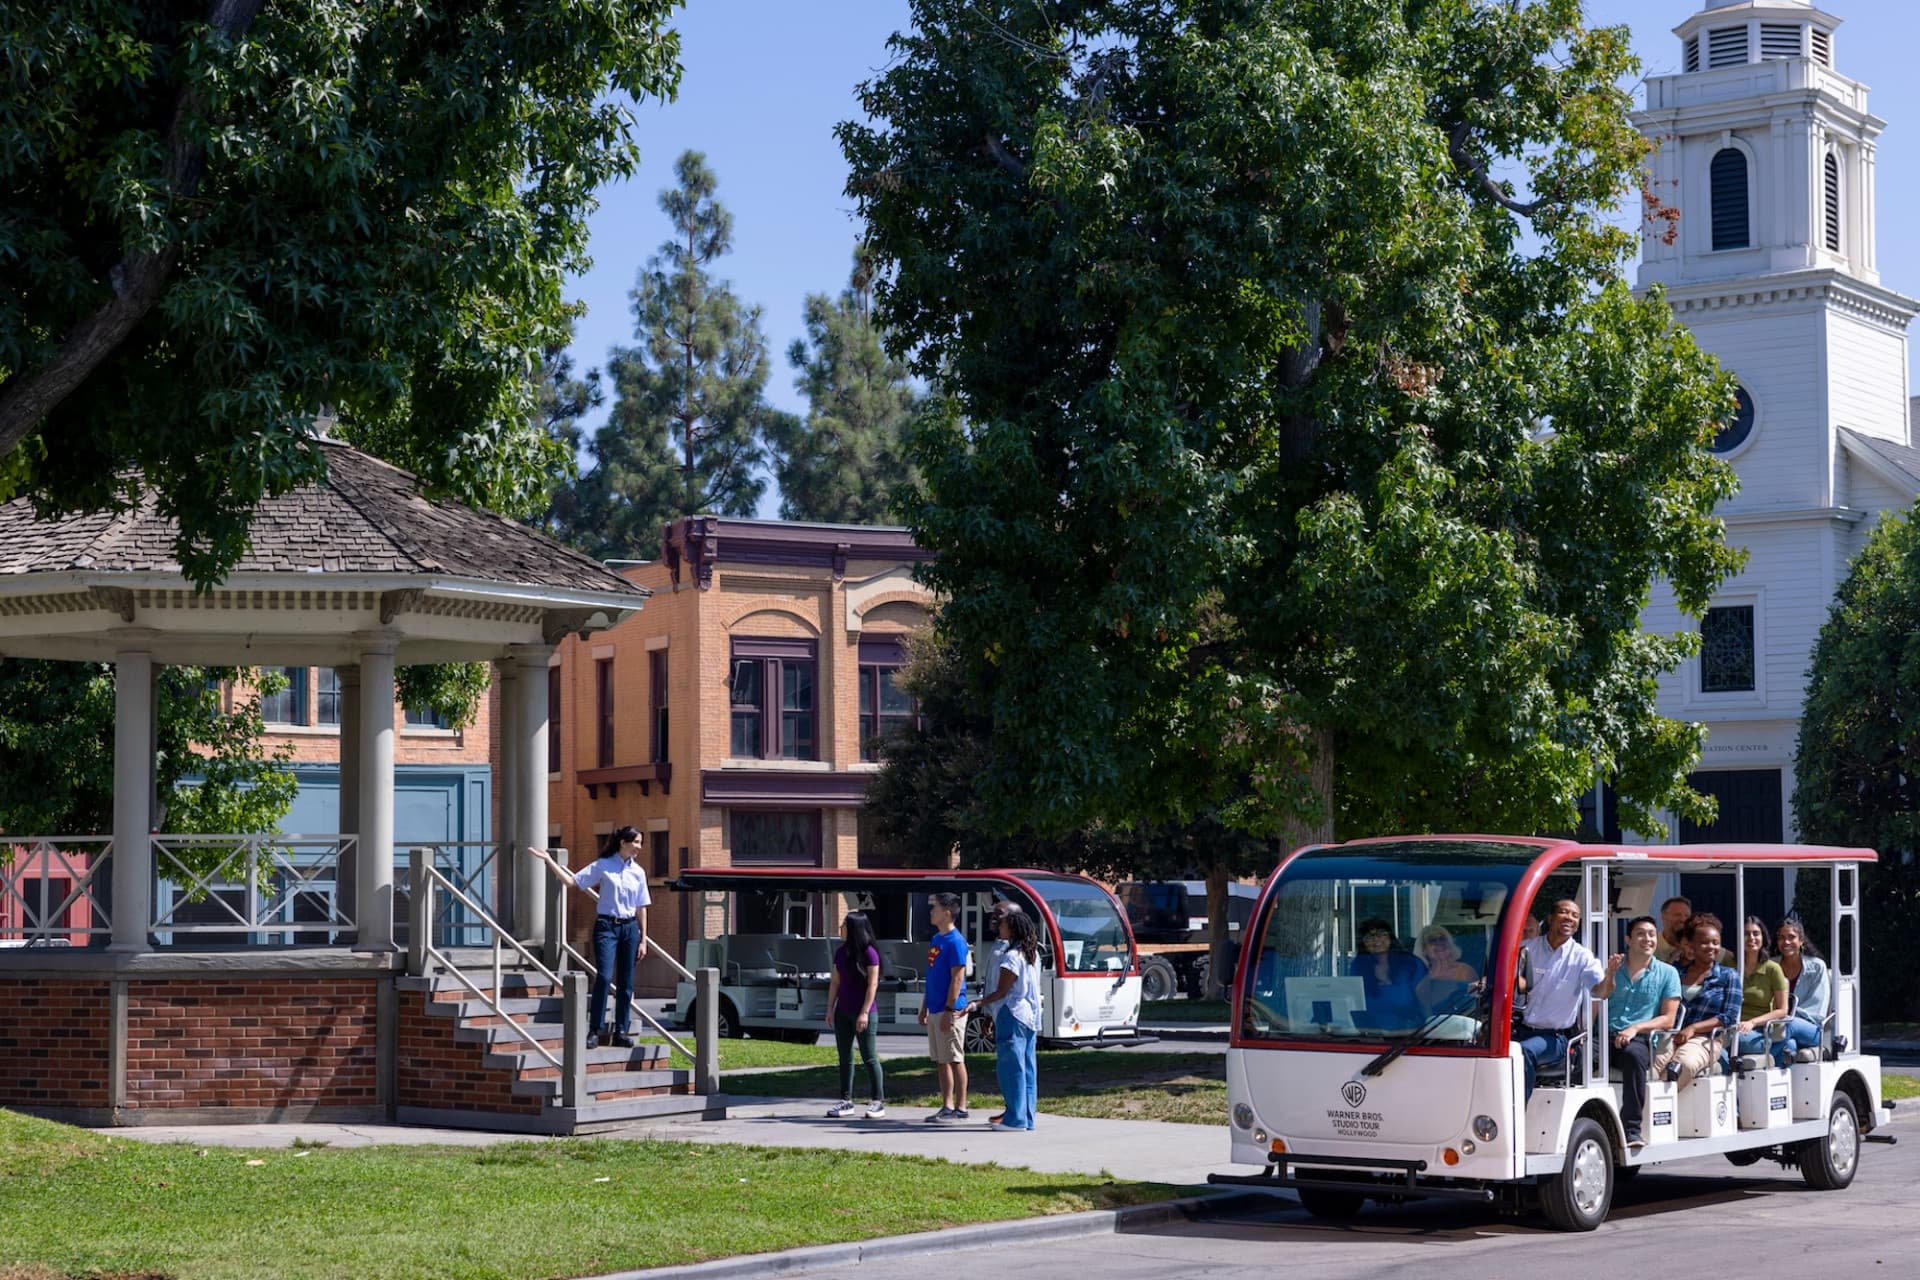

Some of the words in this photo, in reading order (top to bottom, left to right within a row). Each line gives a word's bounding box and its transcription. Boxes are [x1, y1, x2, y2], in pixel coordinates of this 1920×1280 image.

[1735, 744, 1768, 752] CENTER
[1344, 1085, 1363, 1103] WB
[1327, 1110, 1360, 1120] WARNER
[1361, 1112, 1384, 1122] BROS.
[1332, 1119, 1359, 1129] STUDIO
[1360, 1121, 1380, 1130] TOUR
[1337, 1129, 1378, 1138] HOLLYWOOD
